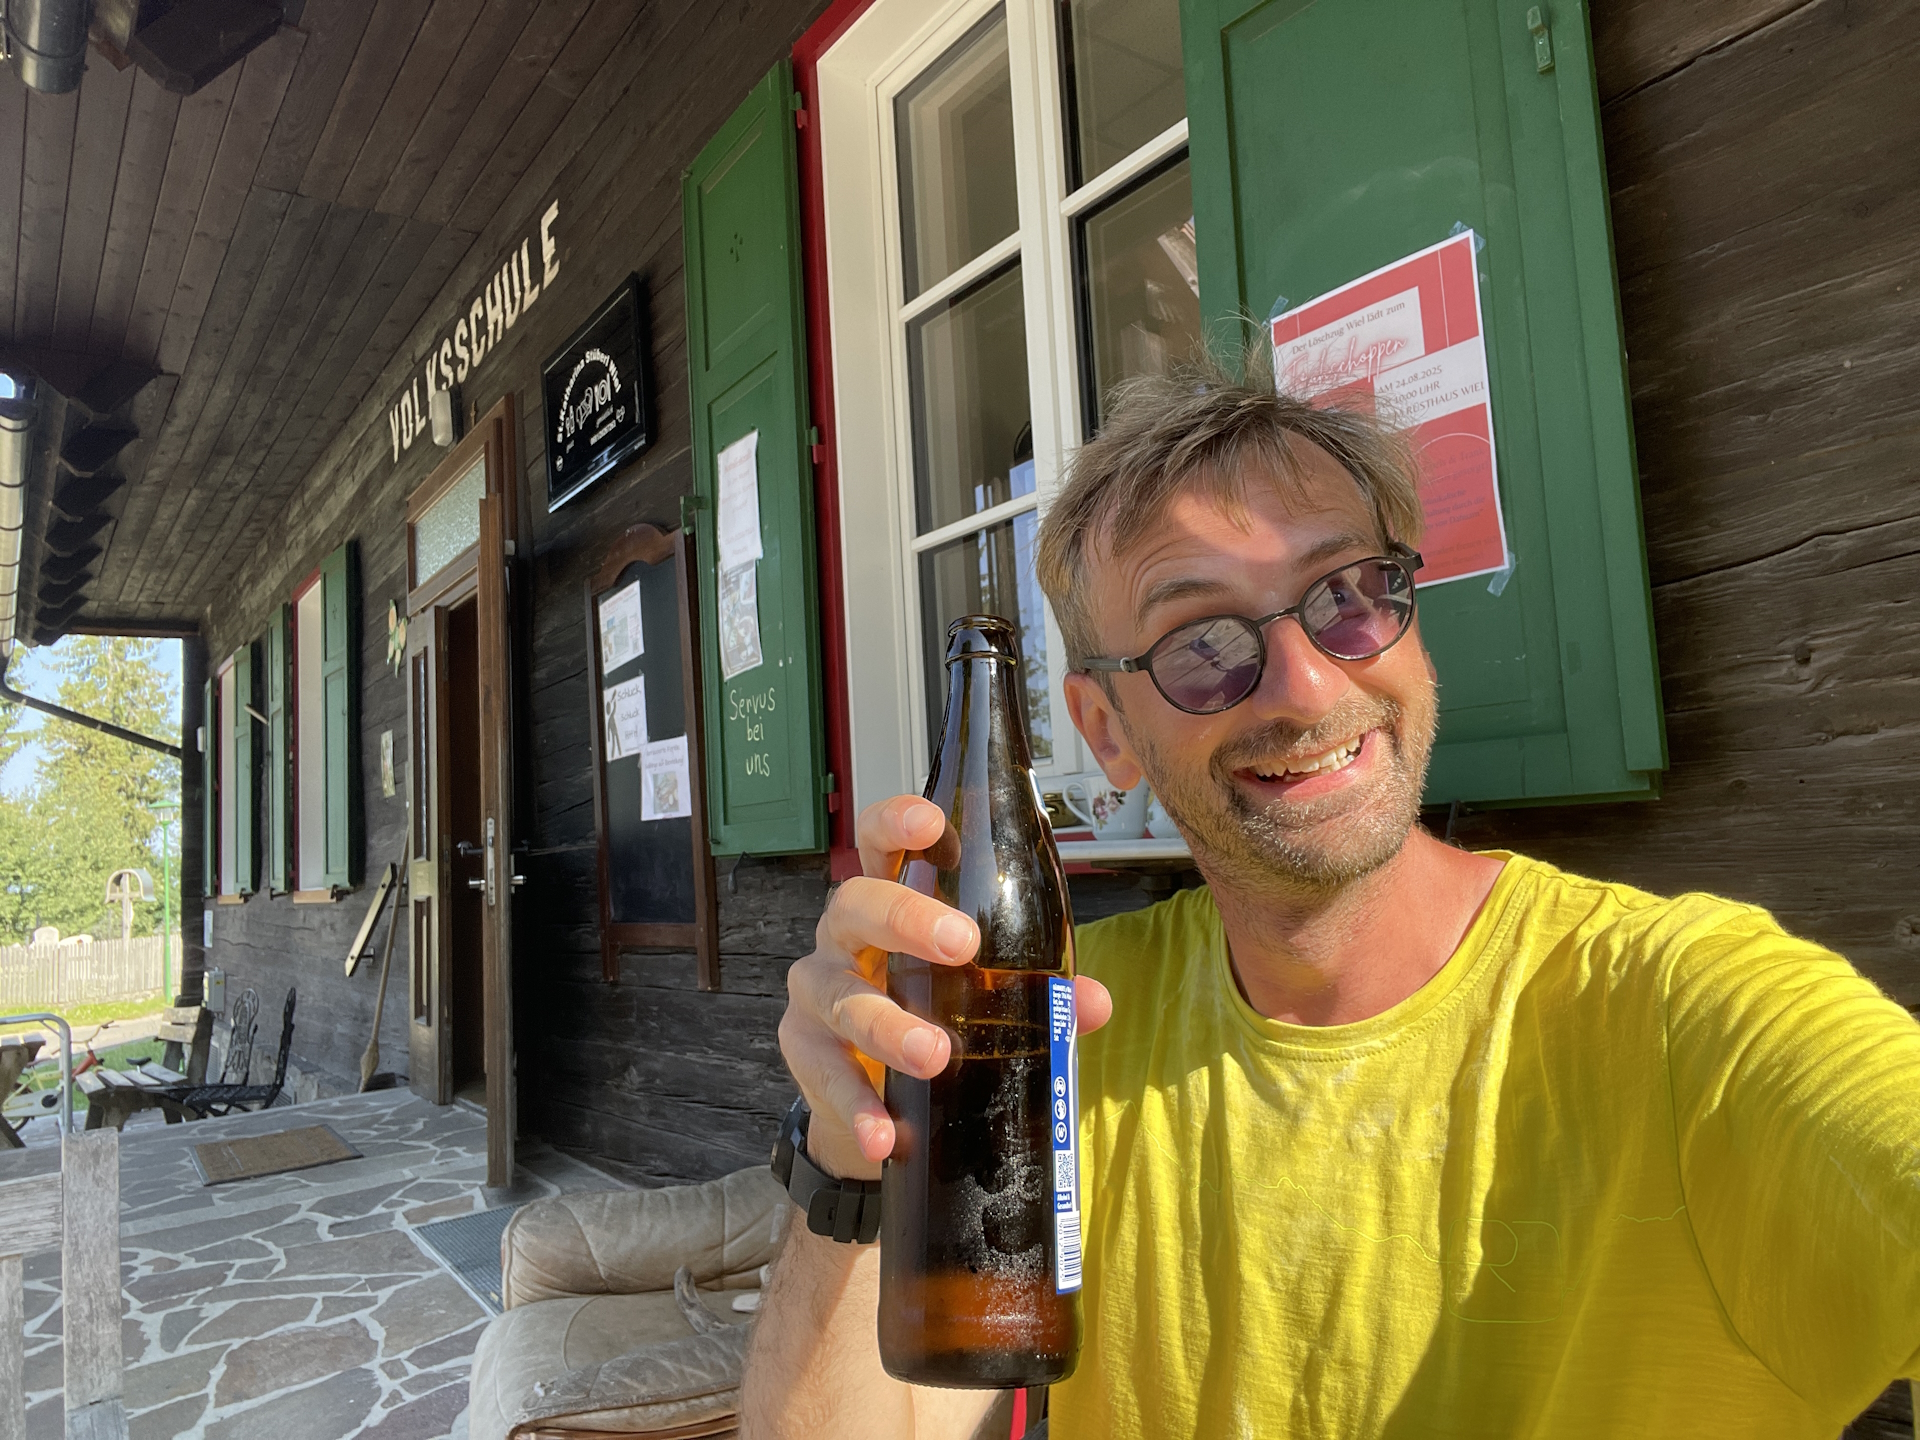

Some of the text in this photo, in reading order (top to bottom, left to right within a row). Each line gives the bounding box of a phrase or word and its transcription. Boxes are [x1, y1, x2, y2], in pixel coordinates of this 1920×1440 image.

[389, 198, 560, 464] VOLKSSCHULE
[1292, 301, 1406, 355] Der Löschzug Wiel lädt zum
[1395, 364, 1443, 388] 24.08.2025
[1419, 380, 1441, 395] UHR
[1406, 389, 1459, 416] RÜSTHAUS
[729, 687, 776, 721] Servus
[747, 716, 764, 741] bei
[746, 753, 770, 777] uns
